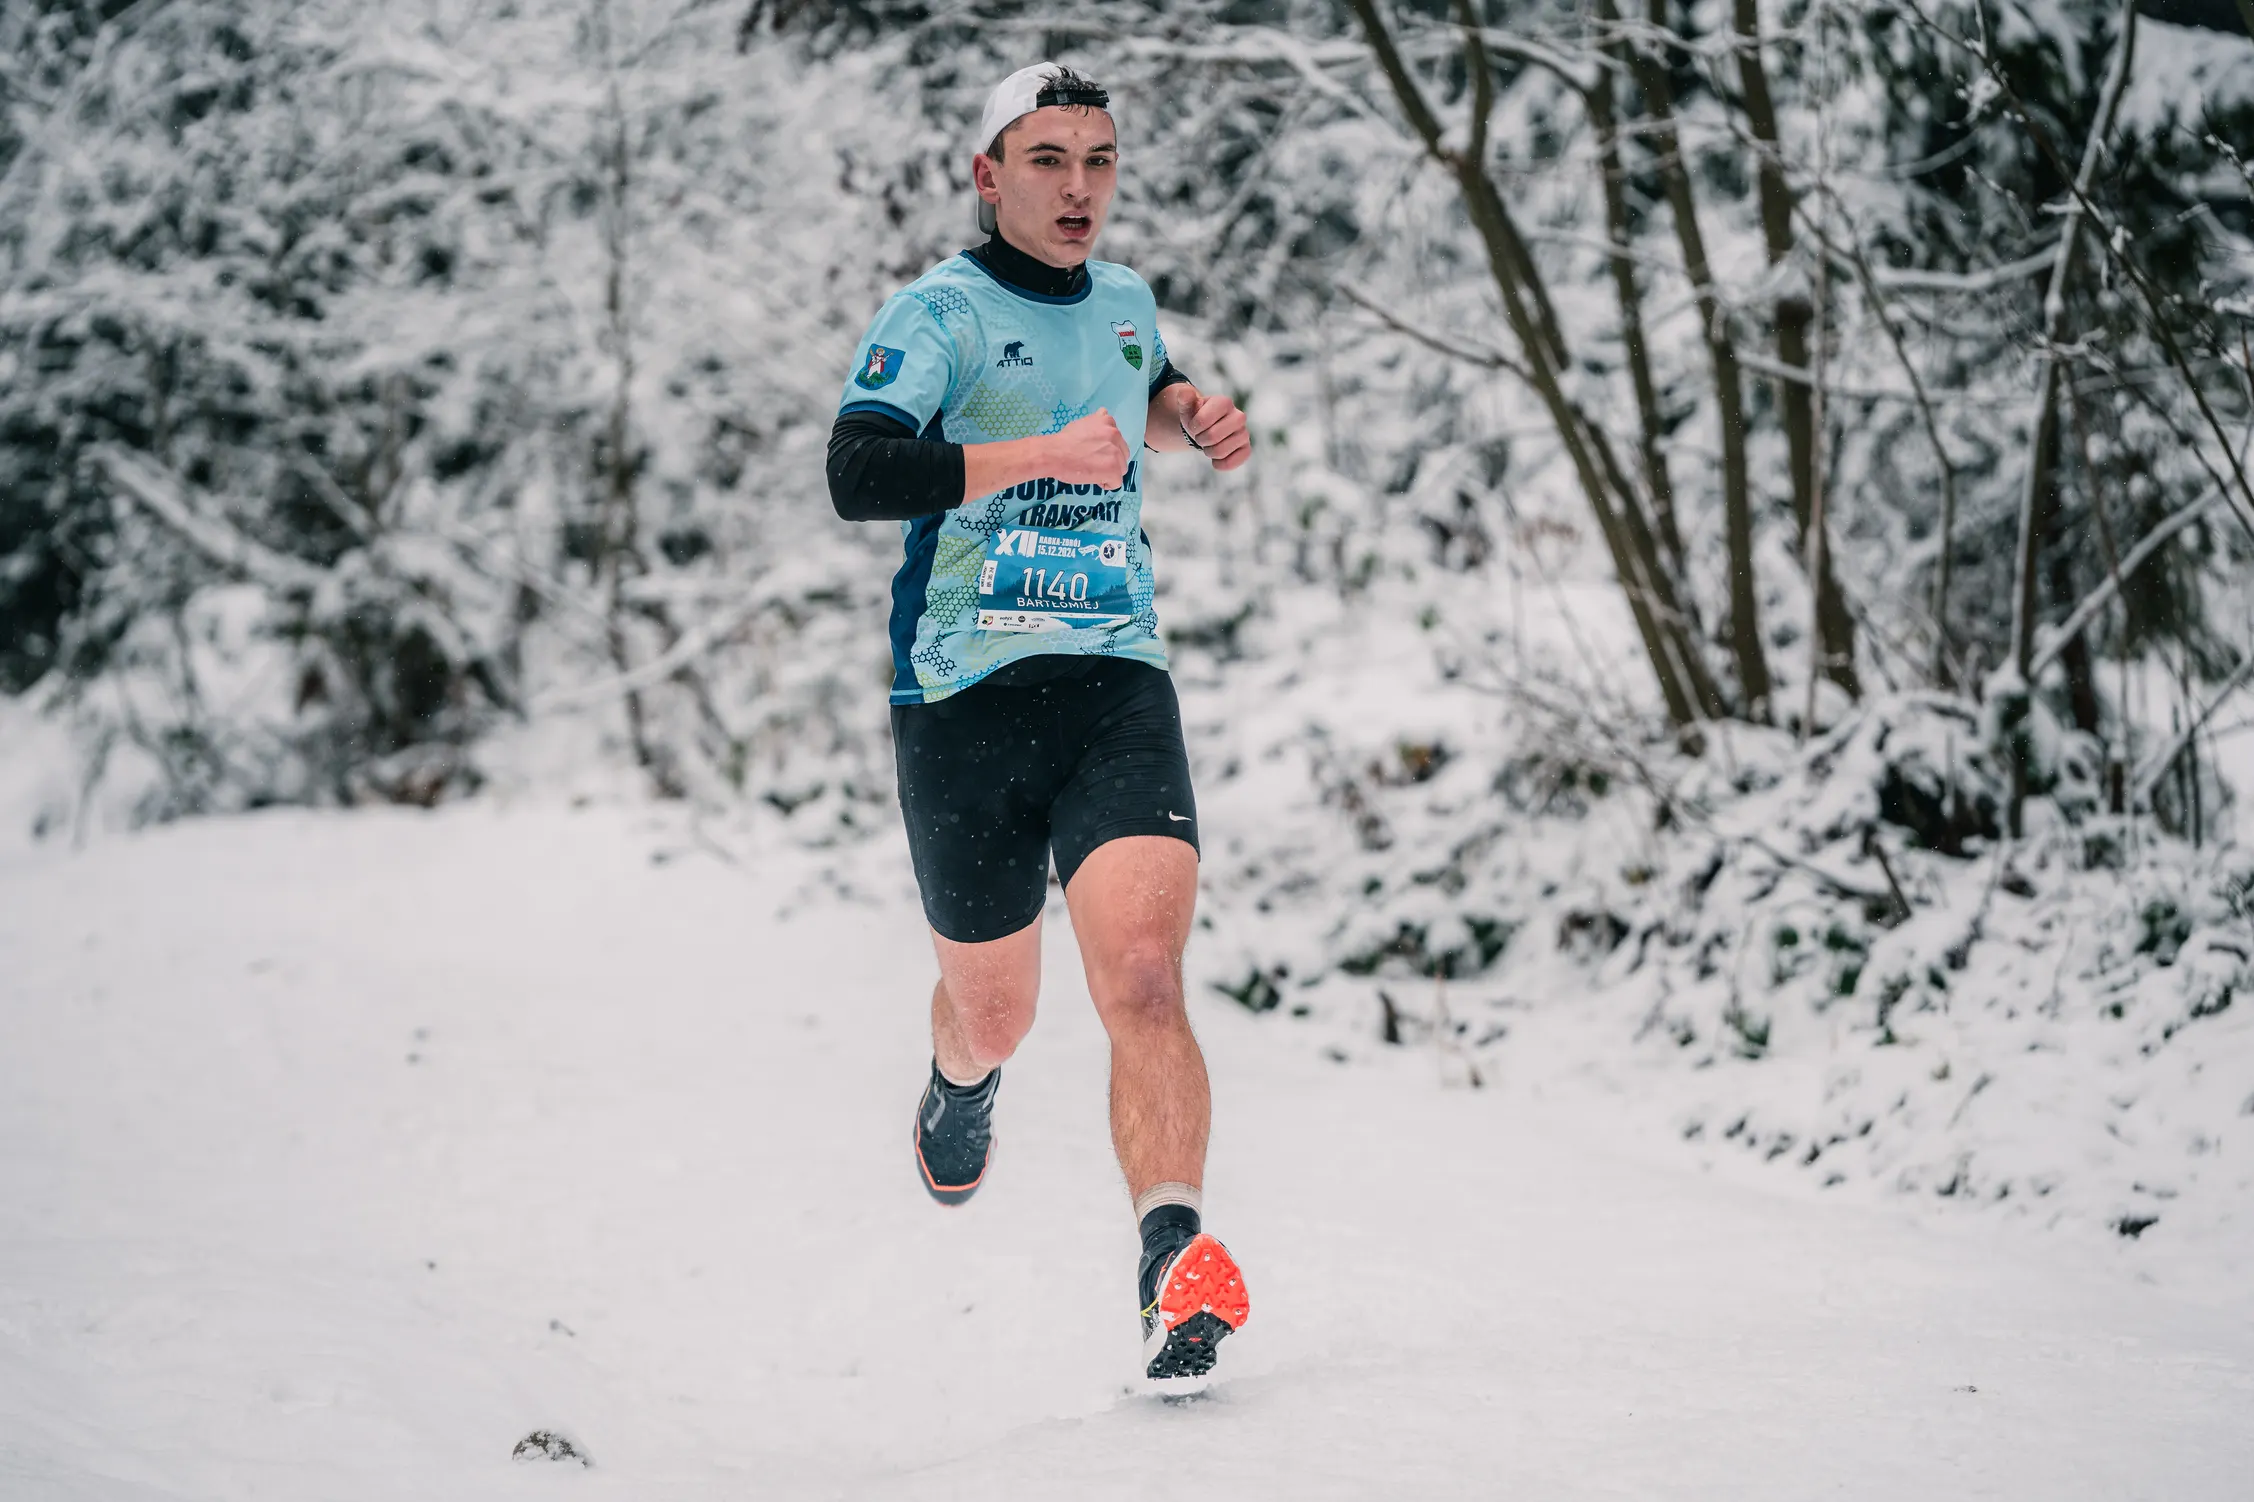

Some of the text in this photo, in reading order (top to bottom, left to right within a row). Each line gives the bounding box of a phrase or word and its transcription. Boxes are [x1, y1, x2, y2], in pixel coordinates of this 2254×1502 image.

[997, 357, 1033, 368] ATTIQ
[1038, 535, 1081, 548] RABKA-ZDRÓJ
[1037, 545, 1076, 559] 15.12.2024
[1023, 567, 1089, 601] 1140
[1016, 597, 1099, 610] BARTŁOMIEJ
